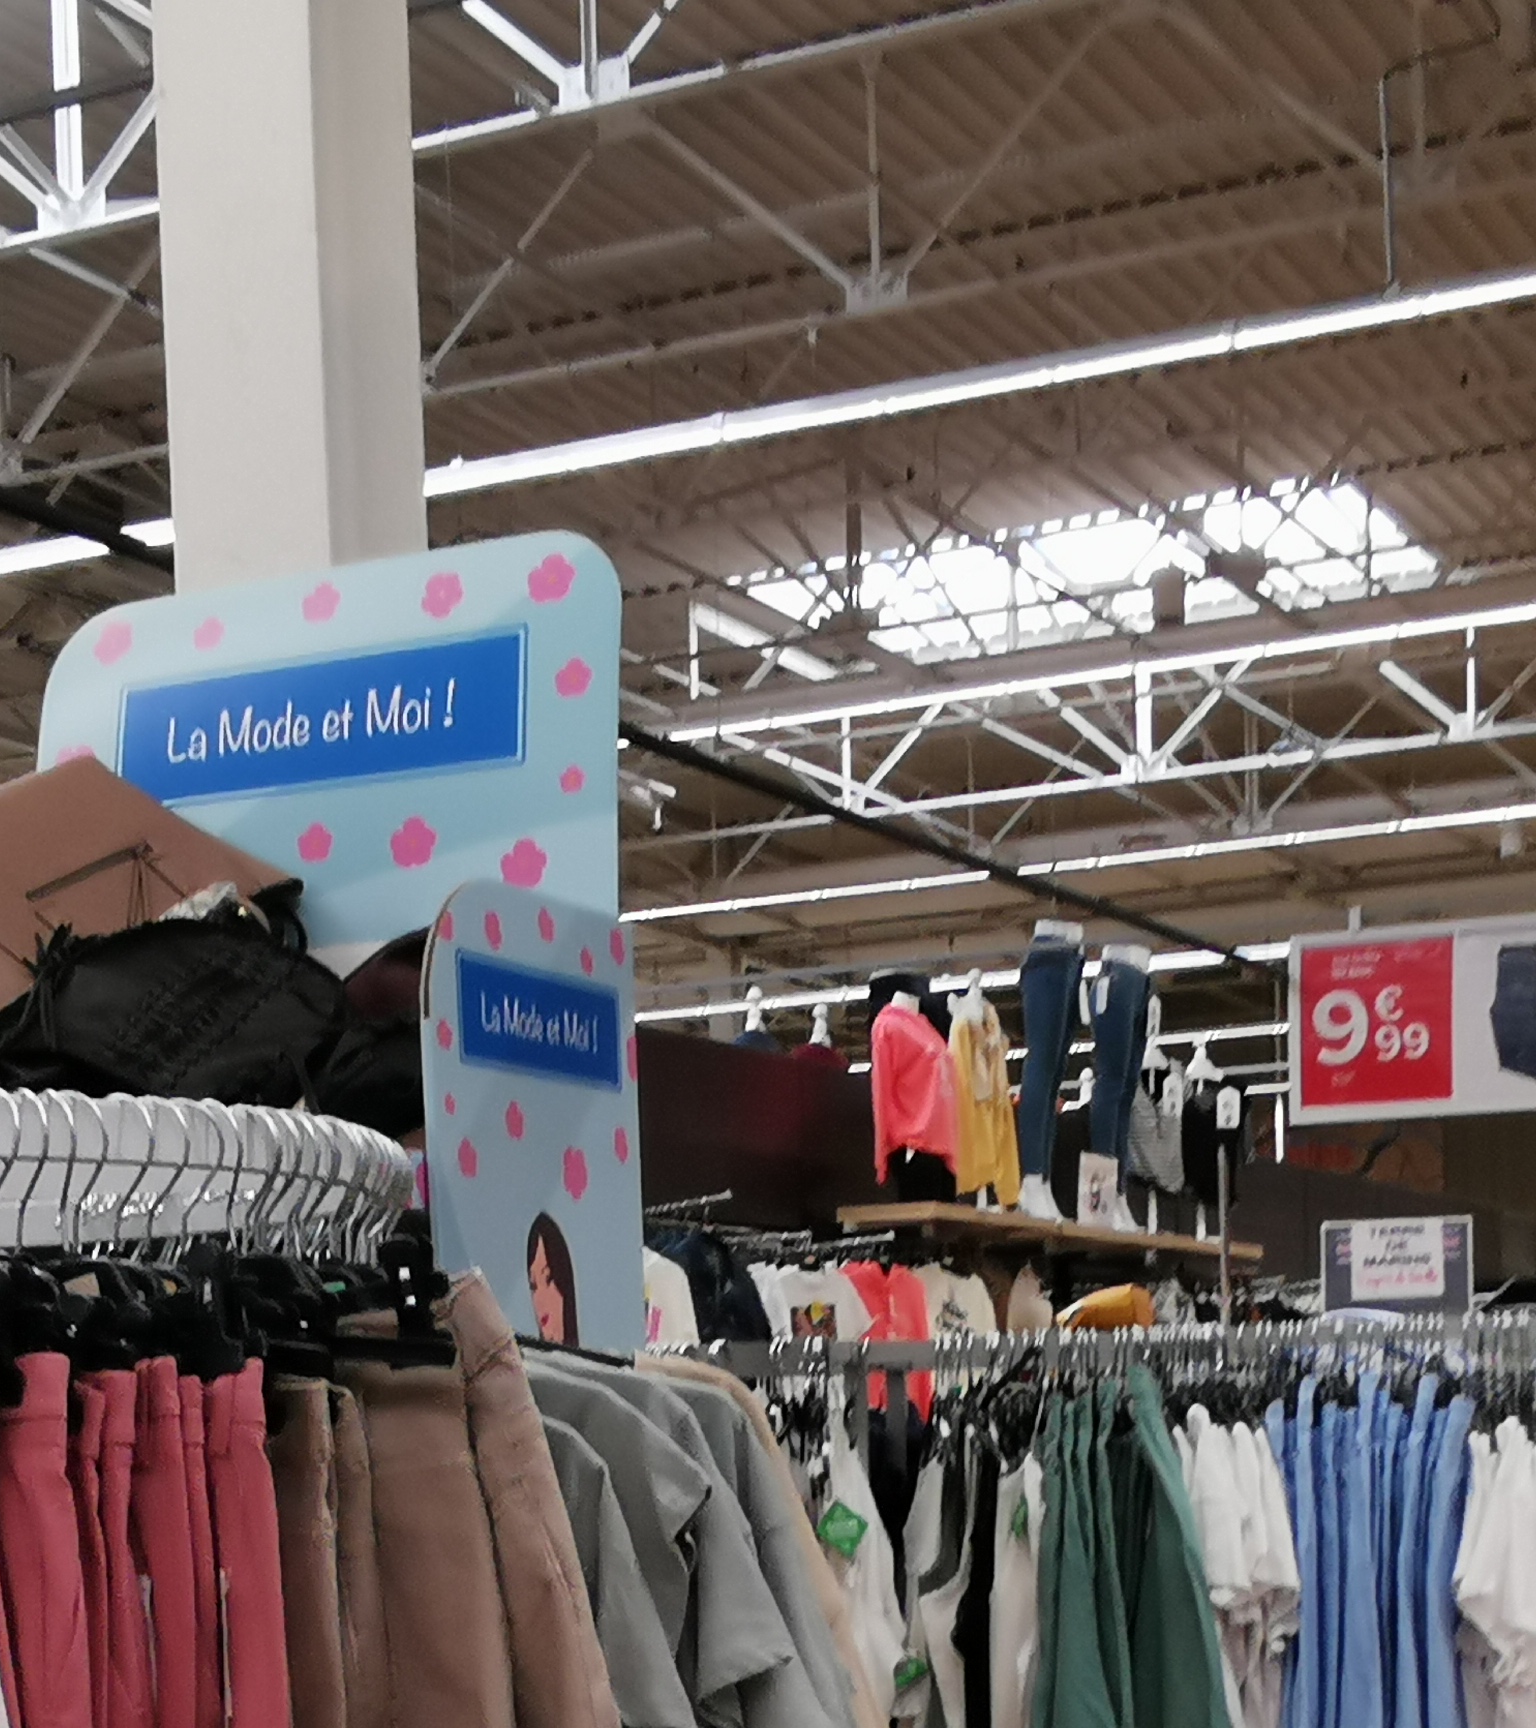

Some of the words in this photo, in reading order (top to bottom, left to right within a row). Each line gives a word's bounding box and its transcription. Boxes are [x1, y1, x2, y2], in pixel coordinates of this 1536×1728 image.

[167, 717, 207, 764] La
[218, 701, 312, 758] Mode
[322, 700, 354, 742] et
[366, 685, 431, 738] Moi
[443, 677, 456, 728] !
[481, 990, 500, 1034] La
[1312, 989, 1369, 1066] 9
[1375, 1022, 1429, 1062] 99
